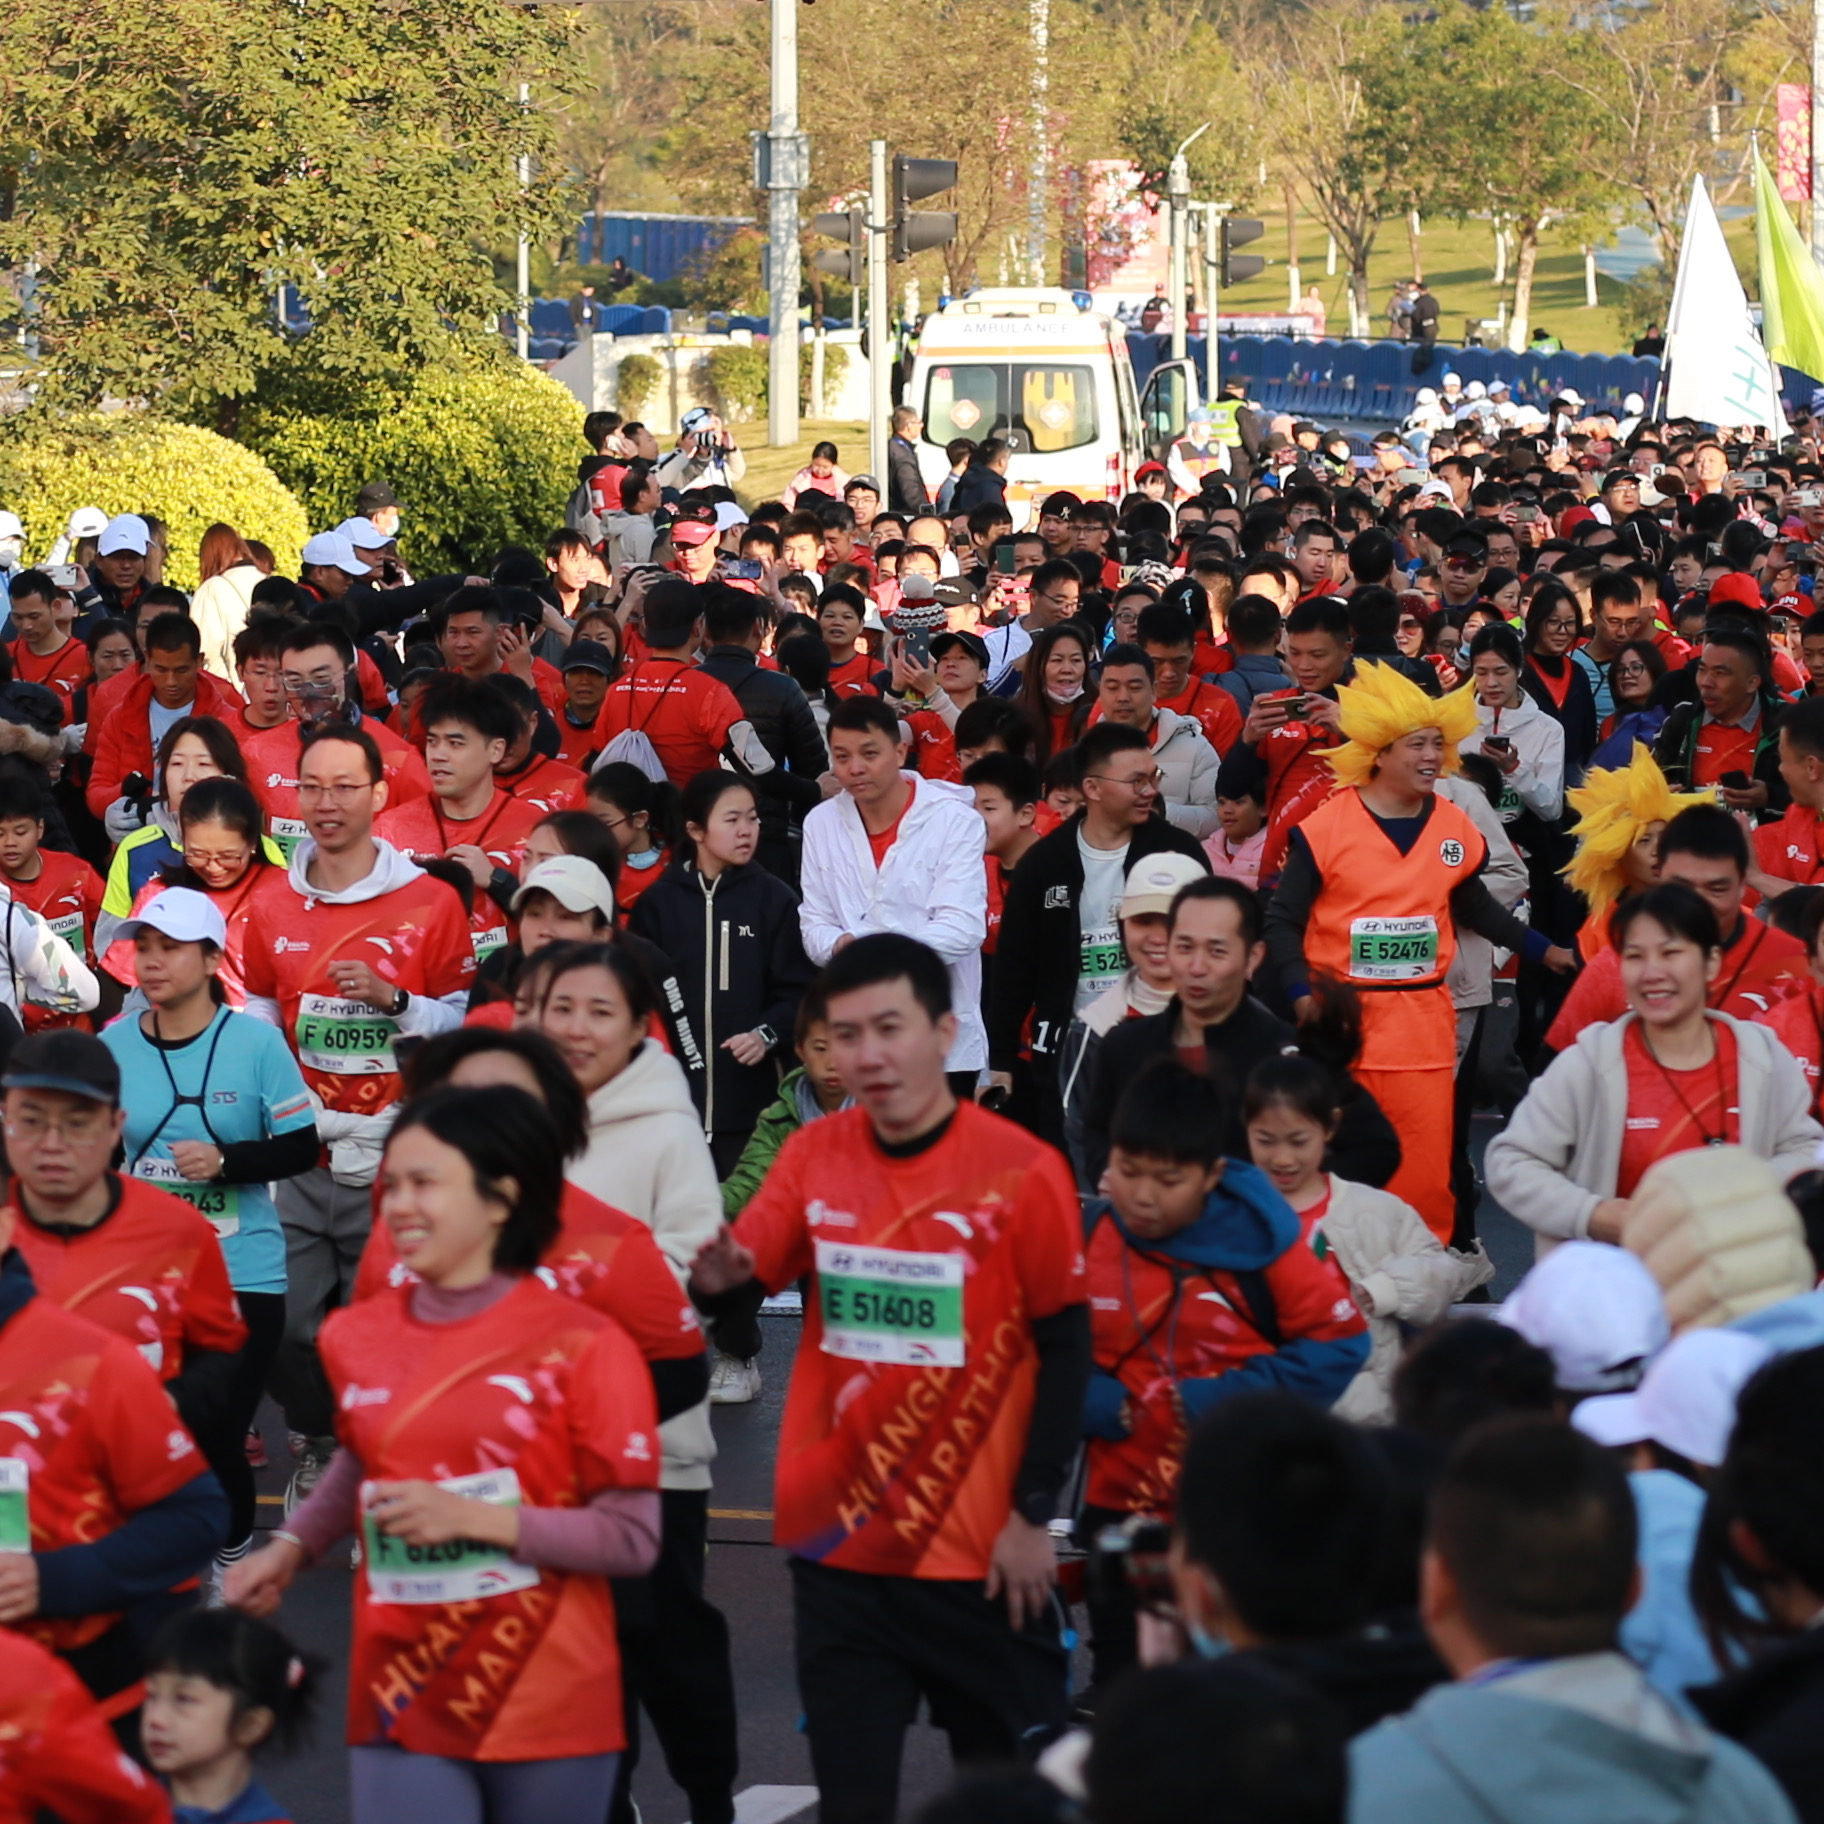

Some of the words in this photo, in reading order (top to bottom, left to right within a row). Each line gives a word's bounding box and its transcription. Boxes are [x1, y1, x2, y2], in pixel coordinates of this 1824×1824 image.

[962, 322, 1070, 334] AMBULANCE
[1441, 842, 1463, 863] 悟
[1359, 942, 1372, 960] E
[1378, 941, 1429, 960] 52476
[1080, 955, 1093, 974] E
[1096, 953, 1127, 972] 525
[662, 976, 683, 1014] OMG
[674, 1015, 706, 1072] MINUTE
[304, 1024, 317, 1045] F
[323, 1028, 389, 1050] 60959
[212, 1091, 238, 1104] STS
[828, 1289, 843, 1321] E
[852, 1292, 937, 1329] 51608
